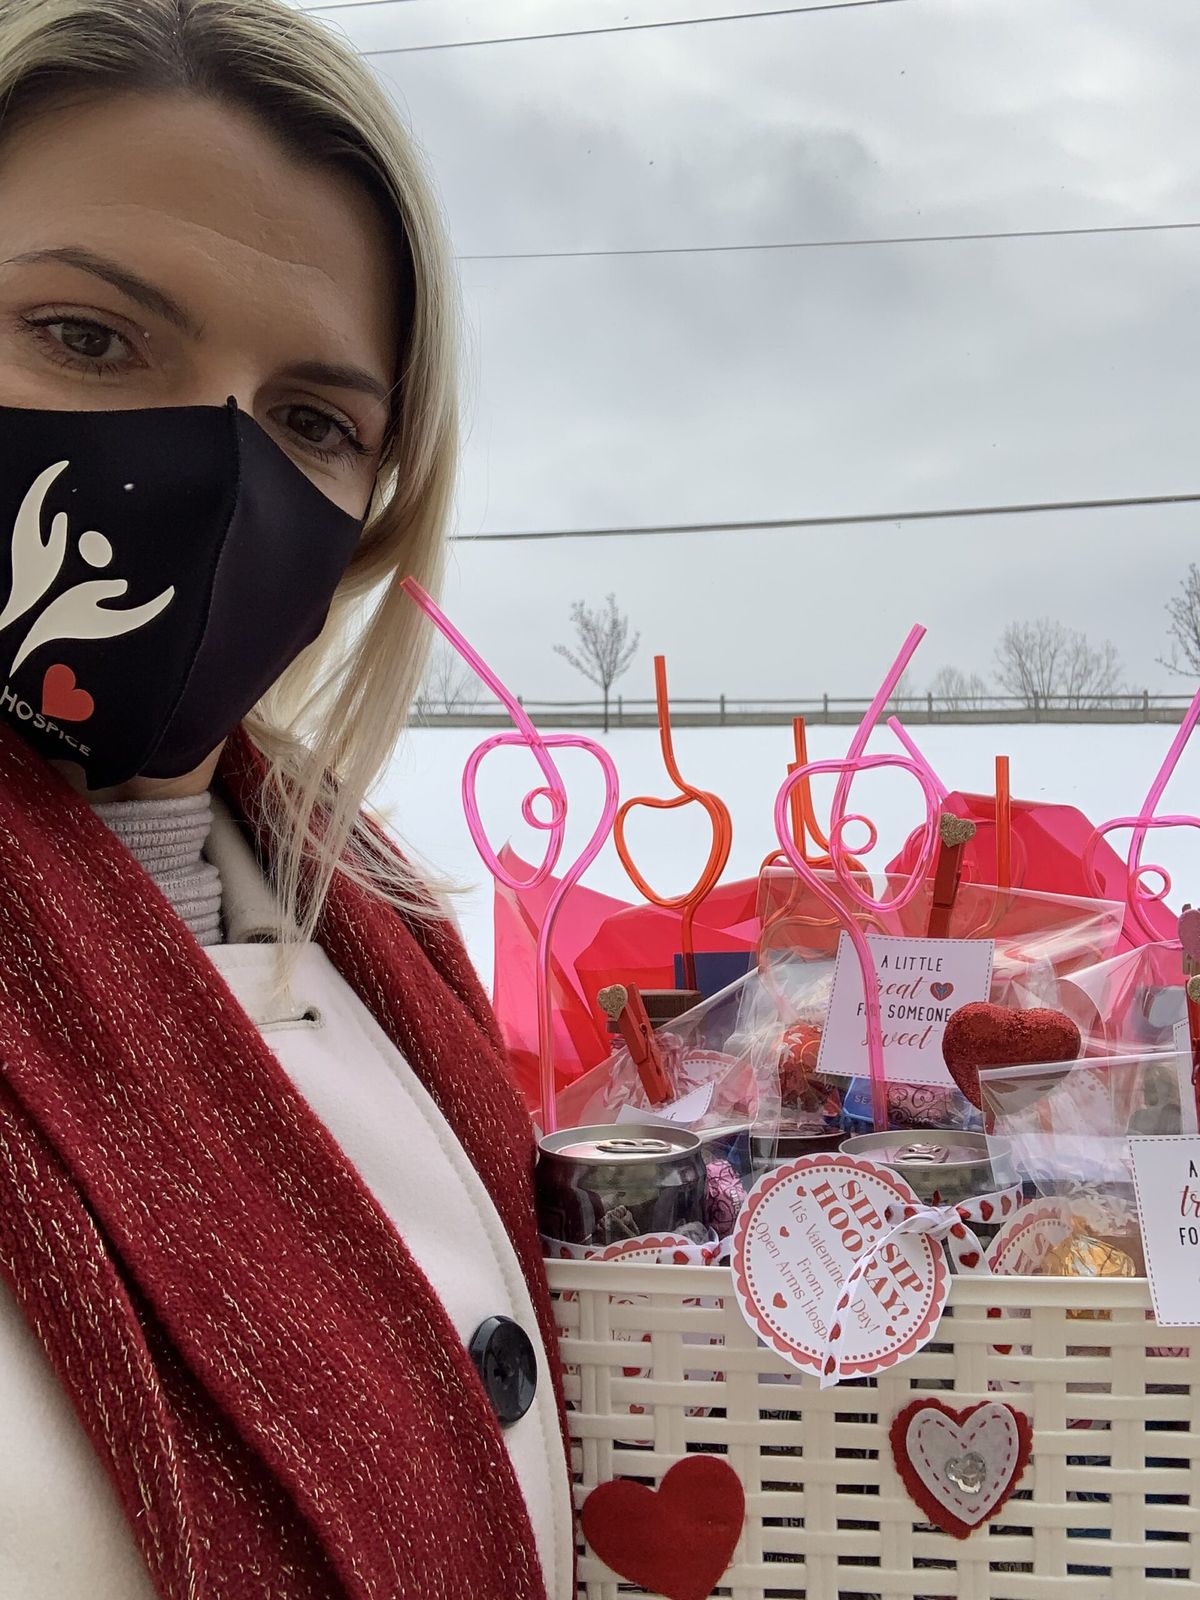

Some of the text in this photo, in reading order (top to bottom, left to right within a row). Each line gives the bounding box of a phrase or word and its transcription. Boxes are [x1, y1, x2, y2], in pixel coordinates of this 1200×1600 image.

[0, 685, 92, 757] HOSPICE
[875, 972, 929, 1000] reat
[881, 955, 943, 972] A LITTLE
[857, 1002, 952, 1023] FR SOMEONE
[1189, 1160, 1199, 1178] A
[839, 1180, 924, 1293] SIP, SIP
[755, 1222, 828, 1344] Open Arms Hosp
[789, 1200, 881, 1334] It's Valentine Day!
